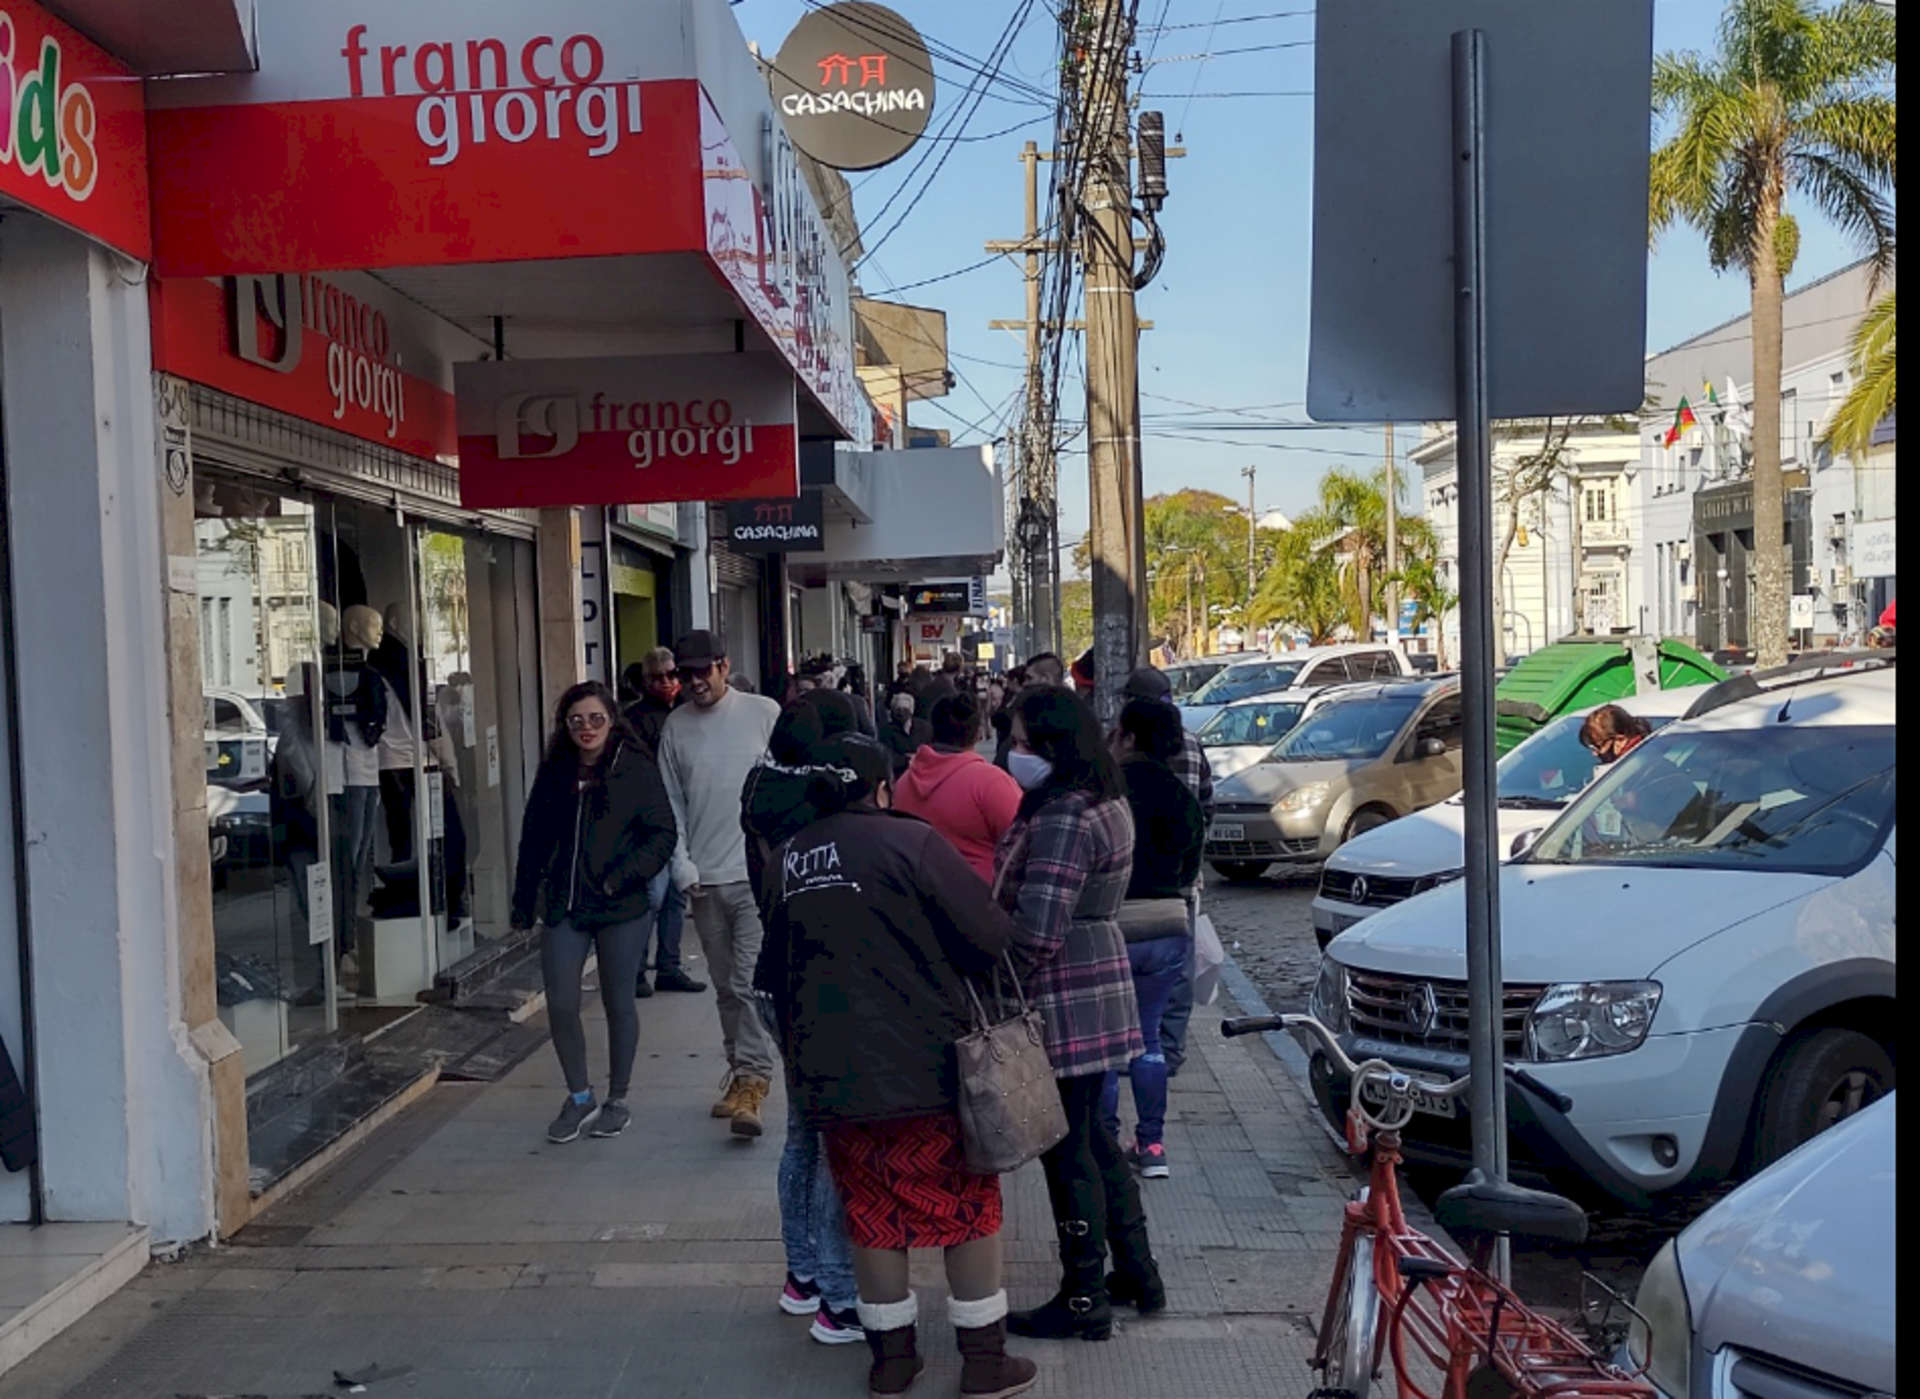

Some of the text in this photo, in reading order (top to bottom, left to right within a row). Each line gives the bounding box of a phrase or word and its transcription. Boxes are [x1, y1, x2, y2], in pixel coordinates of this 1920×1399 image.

[340, 24, 605, 97] franco
[415, 82, 643, 166] giorgi
[781, 88, 925, 116] CASACHINA
[327, 341, 405, 439] giorgi
[590, 391, 733, 432] franco
[628, 418, 754, 469] giorgi
[921, 624, 944, 638] BV
